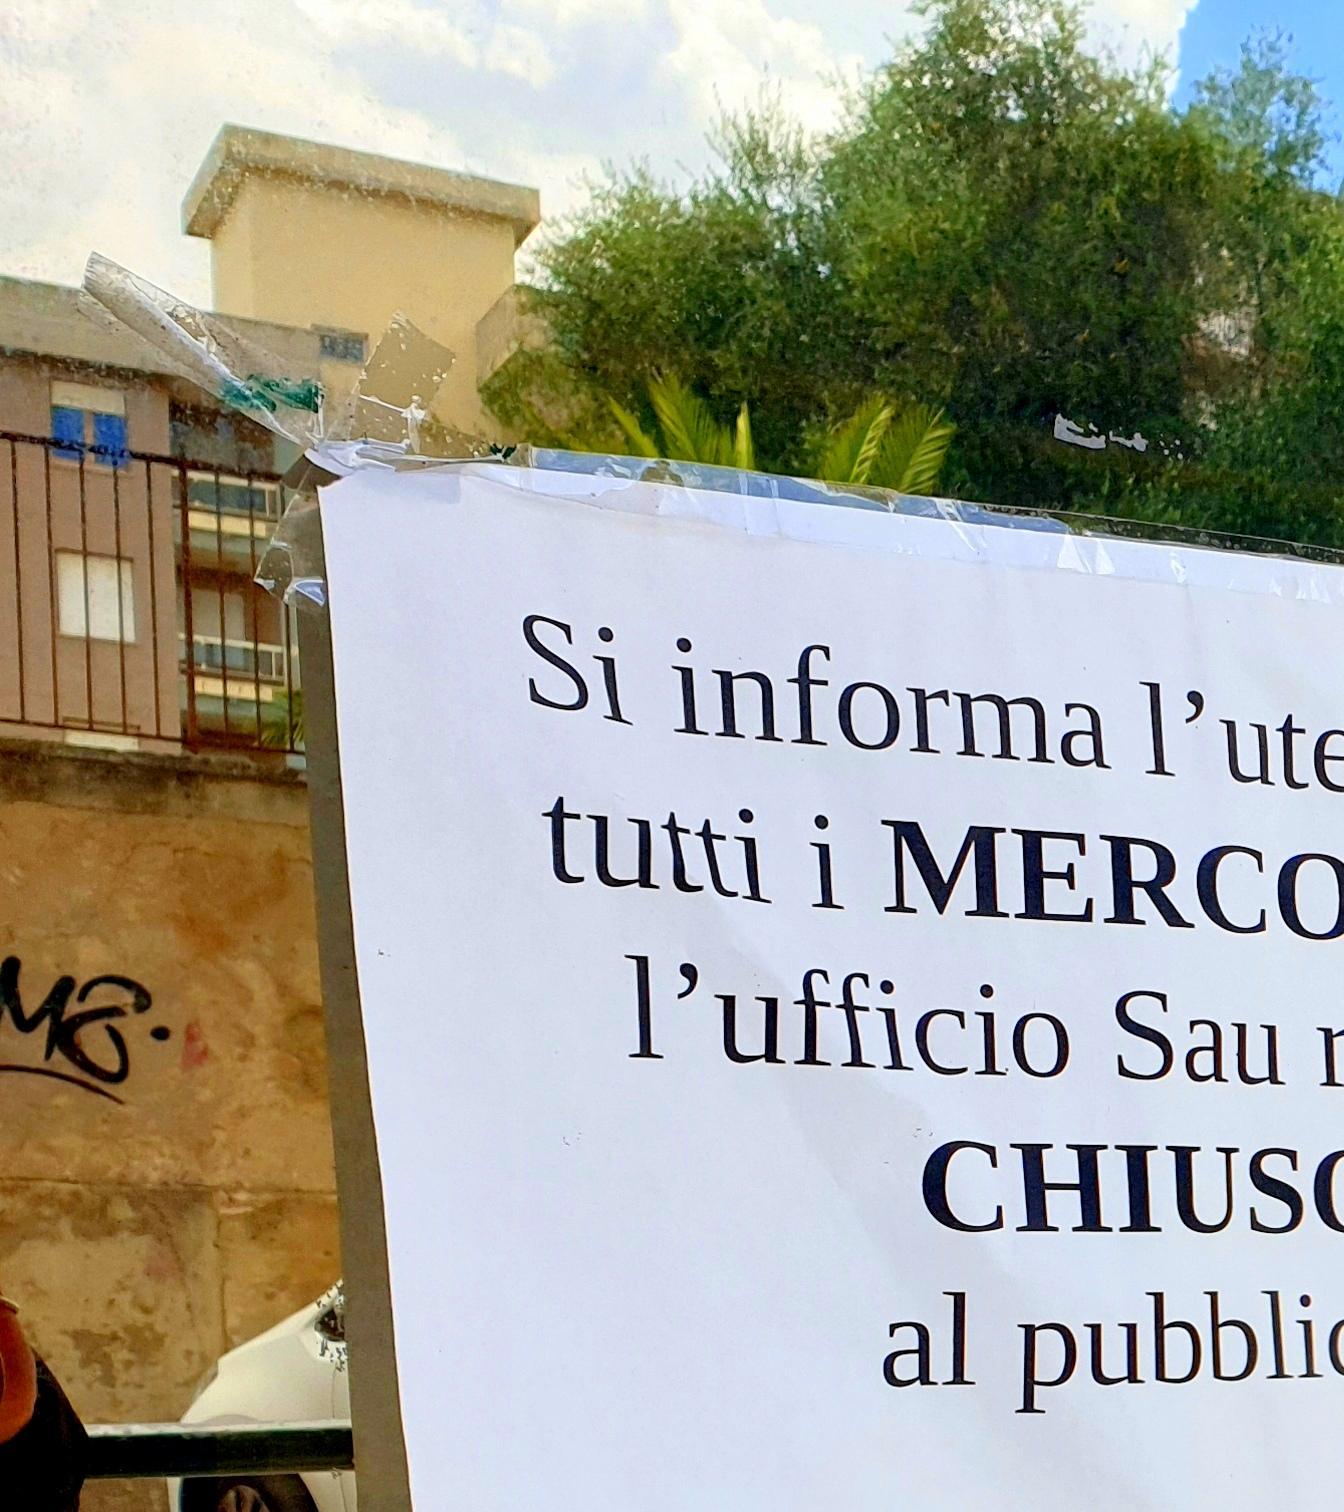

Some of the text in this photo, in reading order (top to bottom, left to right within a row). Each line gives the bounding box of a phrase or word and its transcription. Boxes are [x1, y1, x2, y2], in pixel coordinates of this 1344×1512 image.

[522, 614, 634, 727] Si
[672, 638, 1112, 770] informa
[542, 795, 773, 905] tutti
[811, 815, 845, 910] i
[625, 956, 1070, 1078] l’ufficio
[1116, 989, 1286, 1086] Sau
[882, 1291, 976, 1389] al
